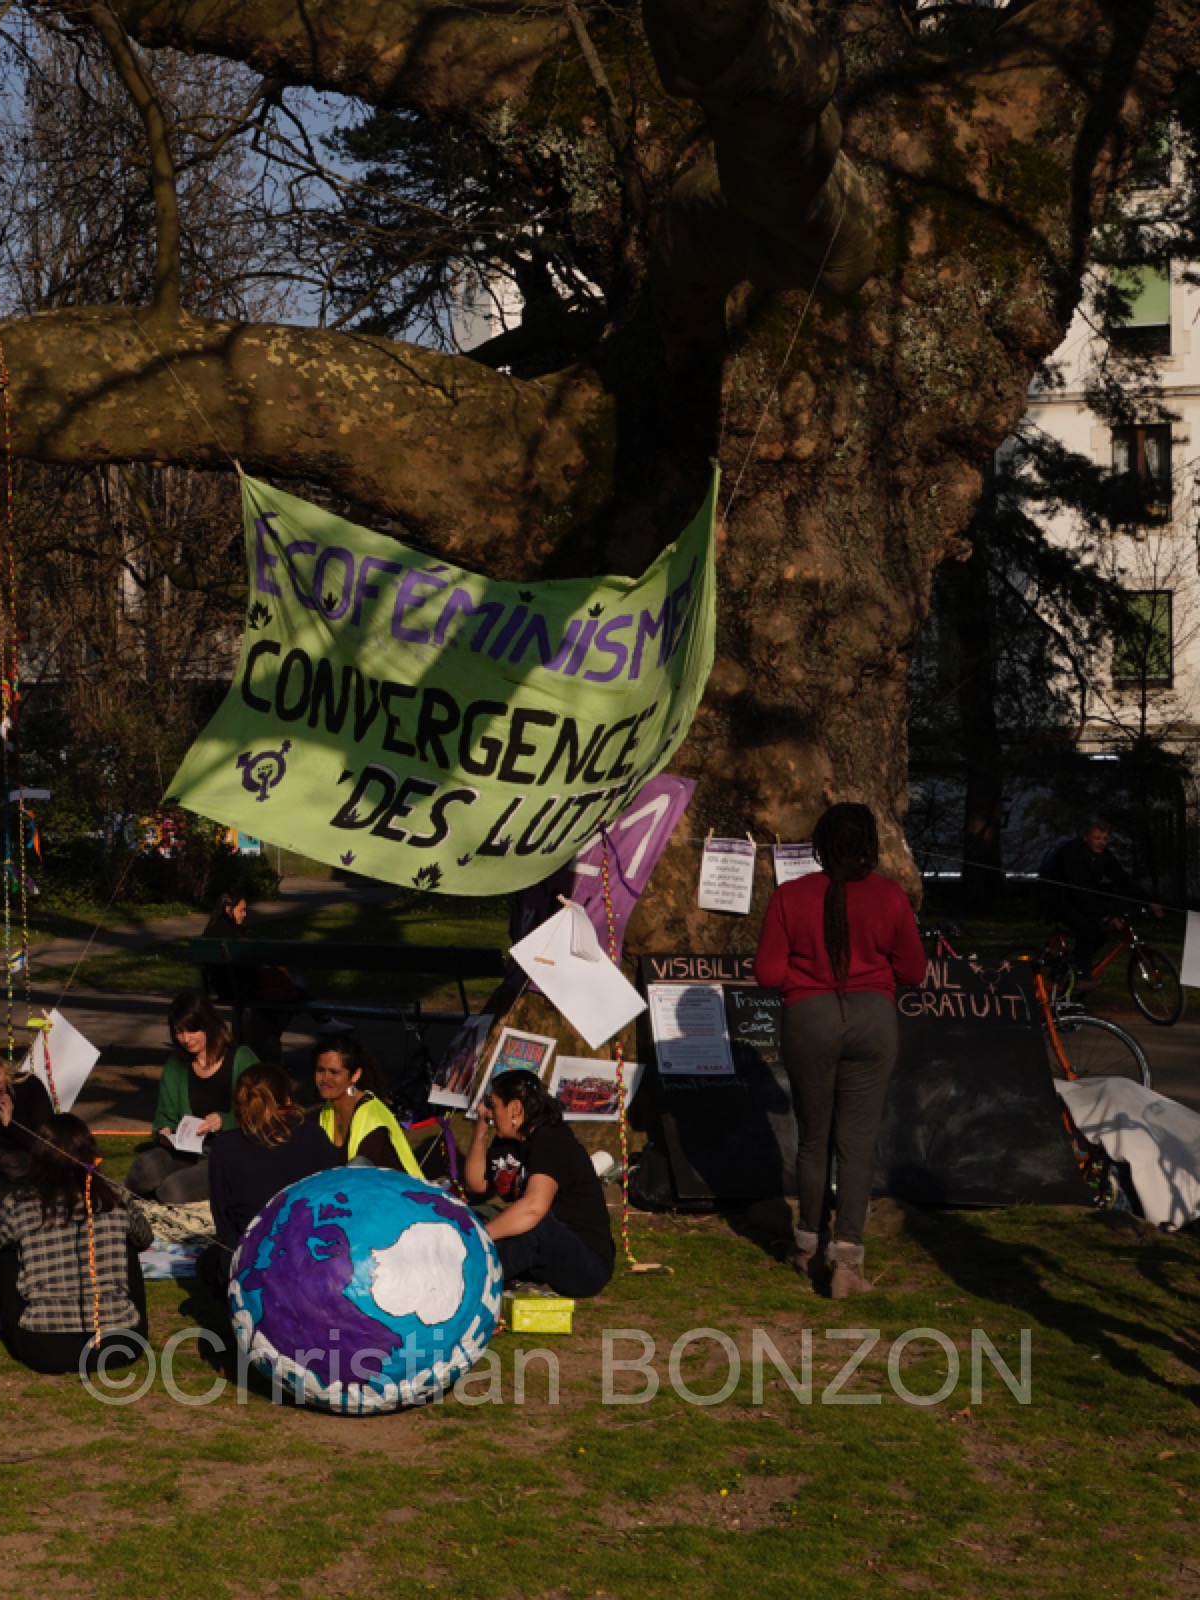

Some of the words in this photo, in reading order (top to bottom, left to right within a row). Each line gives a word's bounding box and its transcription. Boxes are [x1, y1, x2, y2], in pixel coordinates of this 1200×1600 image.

[241, 639, 659, 786] CONVERGENCE
[476, 745, 666, 858] LUTT
[898, 991, 1022, 1021] GRATUIT
